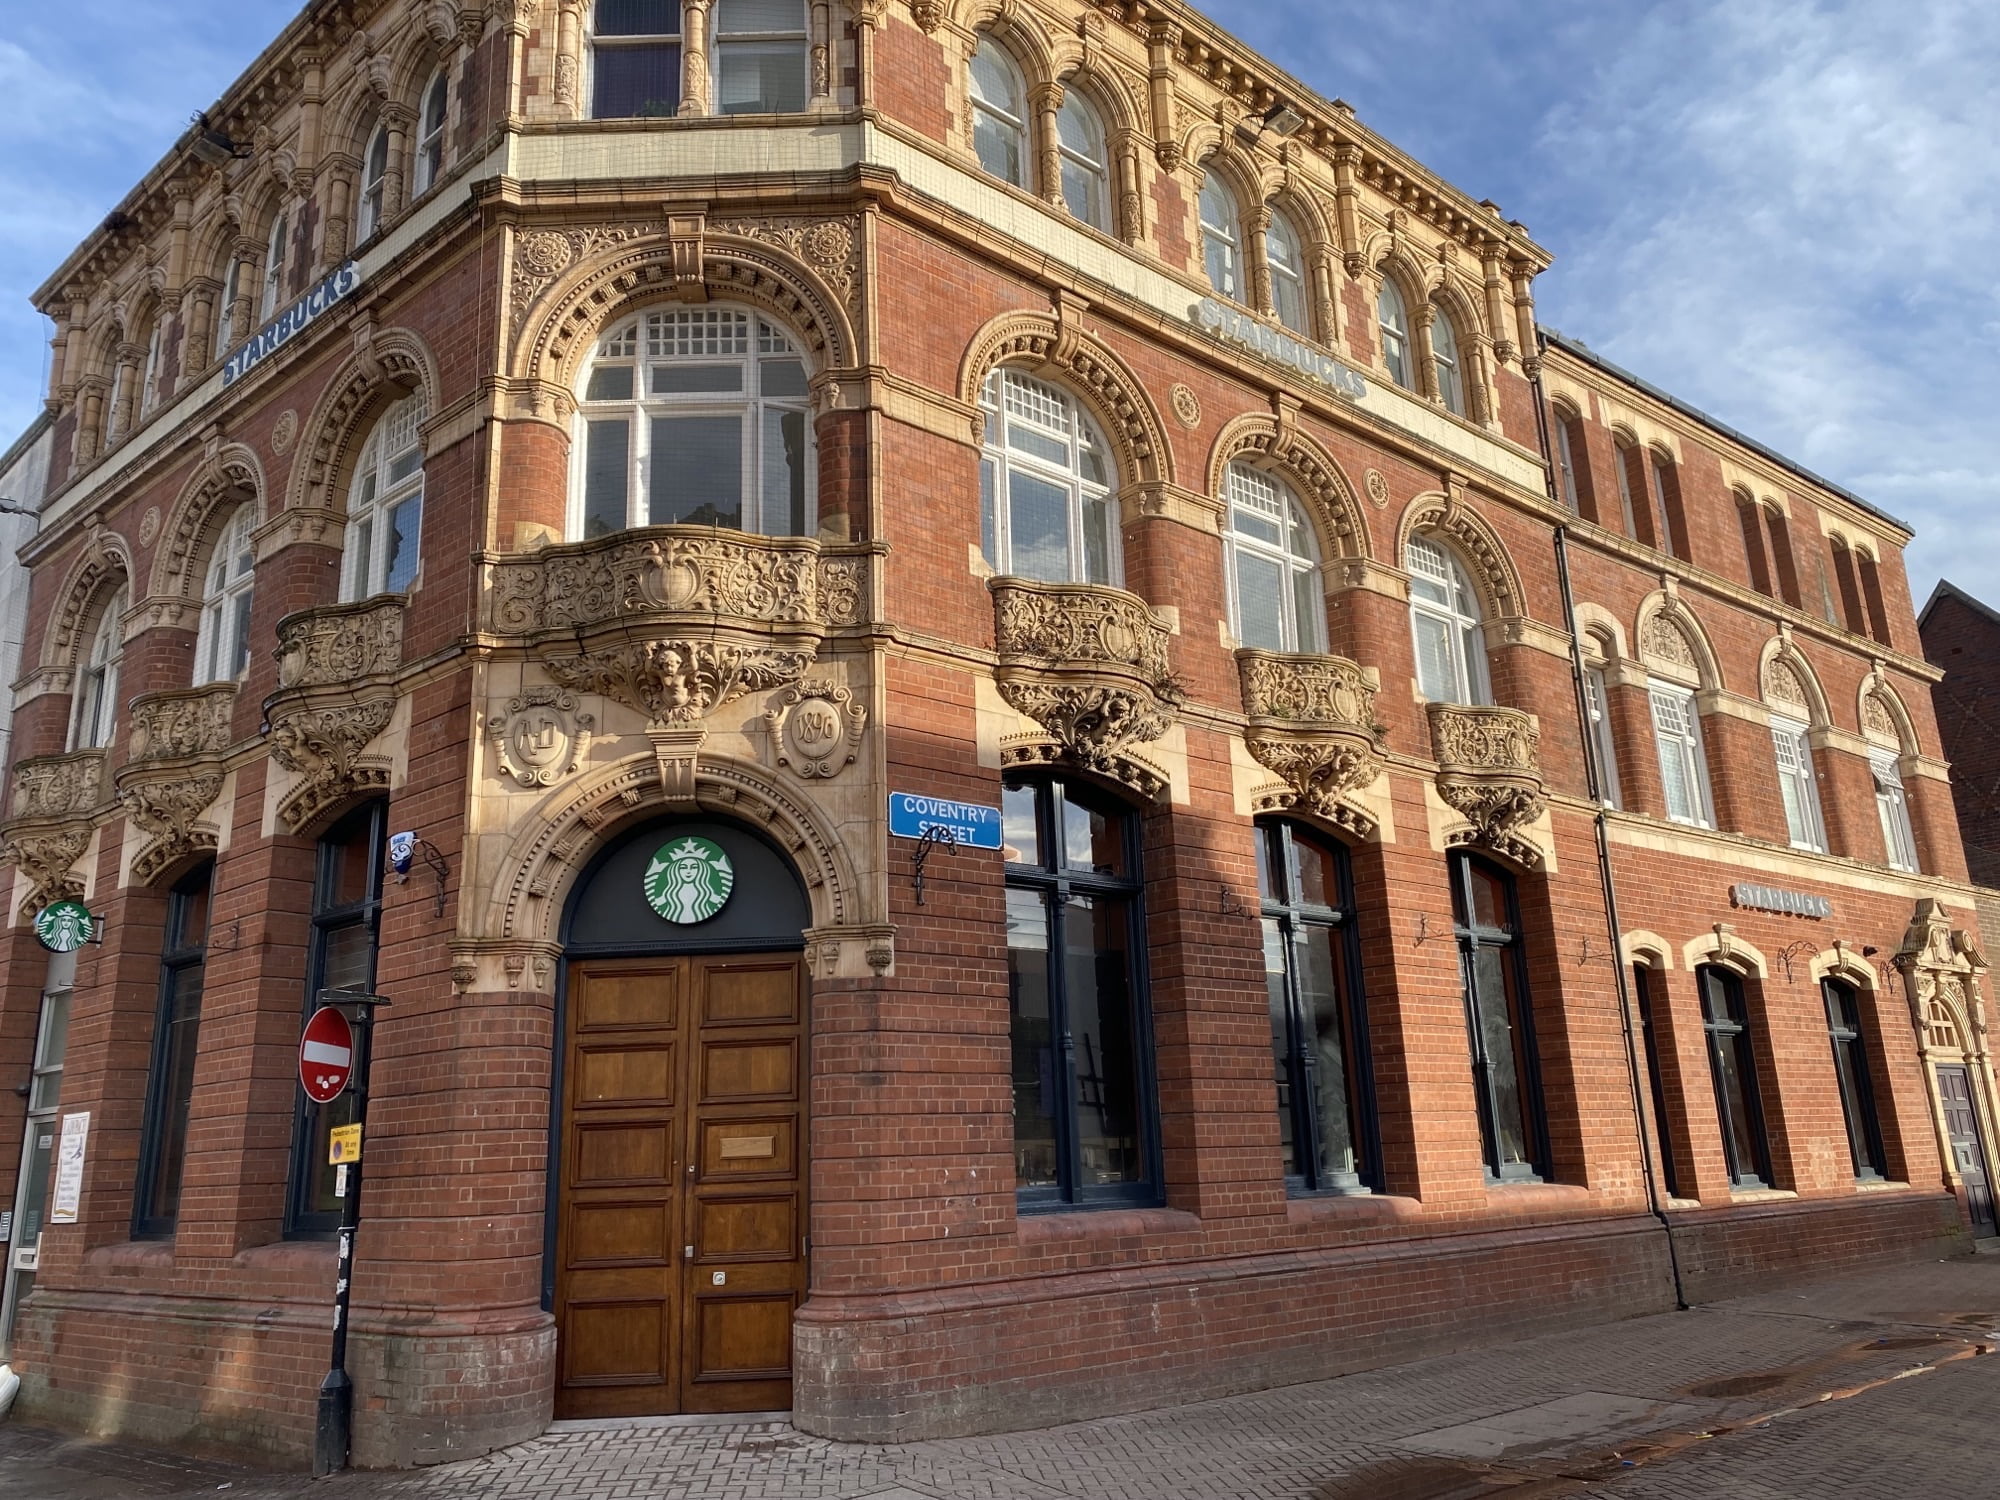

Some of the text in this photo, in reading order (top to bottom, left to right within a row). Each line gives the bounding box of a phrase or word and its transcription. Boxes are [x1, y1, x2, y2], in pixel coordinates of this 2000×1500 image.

[223, 260, 357, 386] STARBUCKS
[1201, 297, 1367, 400] STARBUCKS
[903, 797, 988, 824] COVENTRY
[1736, 882, 1832, 919] STARBUCKS
